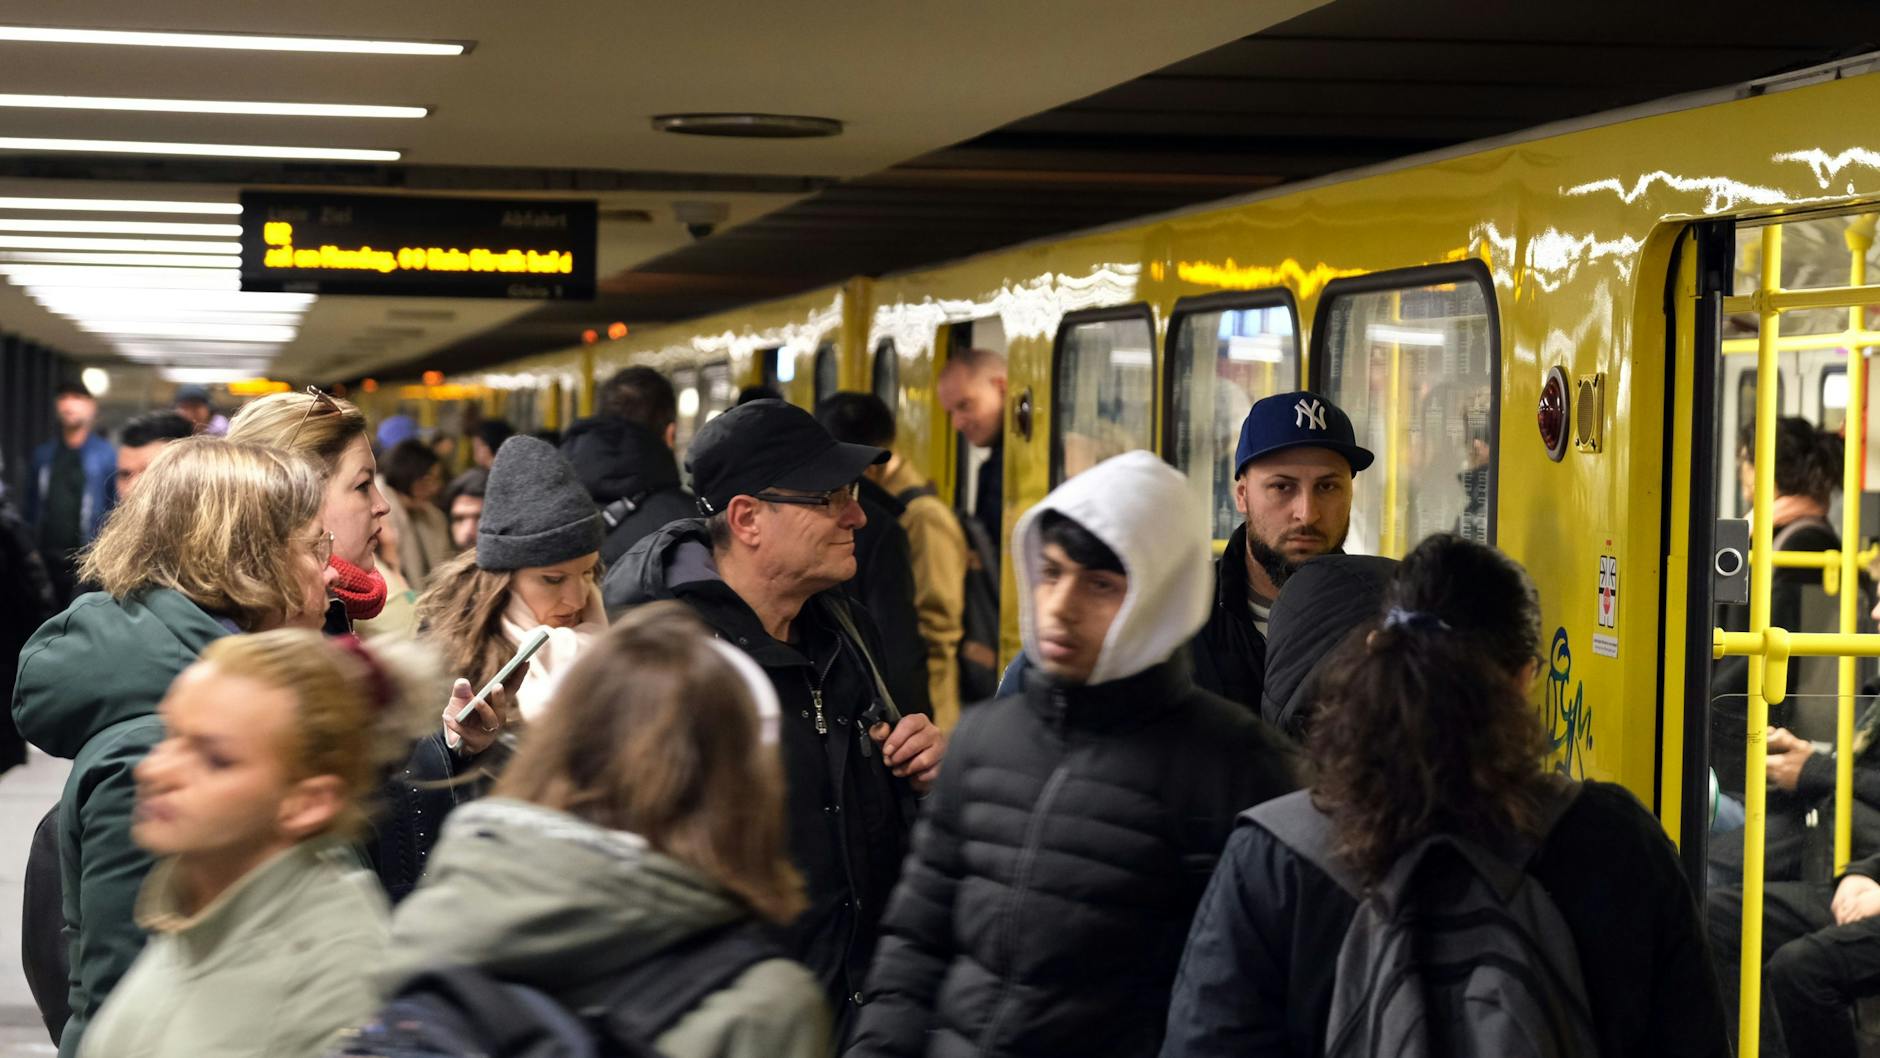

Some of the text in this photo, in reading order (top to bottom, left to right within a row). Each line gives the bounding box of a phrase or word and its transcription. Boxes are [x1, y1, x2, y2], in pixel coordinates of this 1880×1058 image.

[502, 210, 567, 227] Abfahrt
[507, 284, 550, 297] Gleis
[1294, 399, 1327, 430] NY
